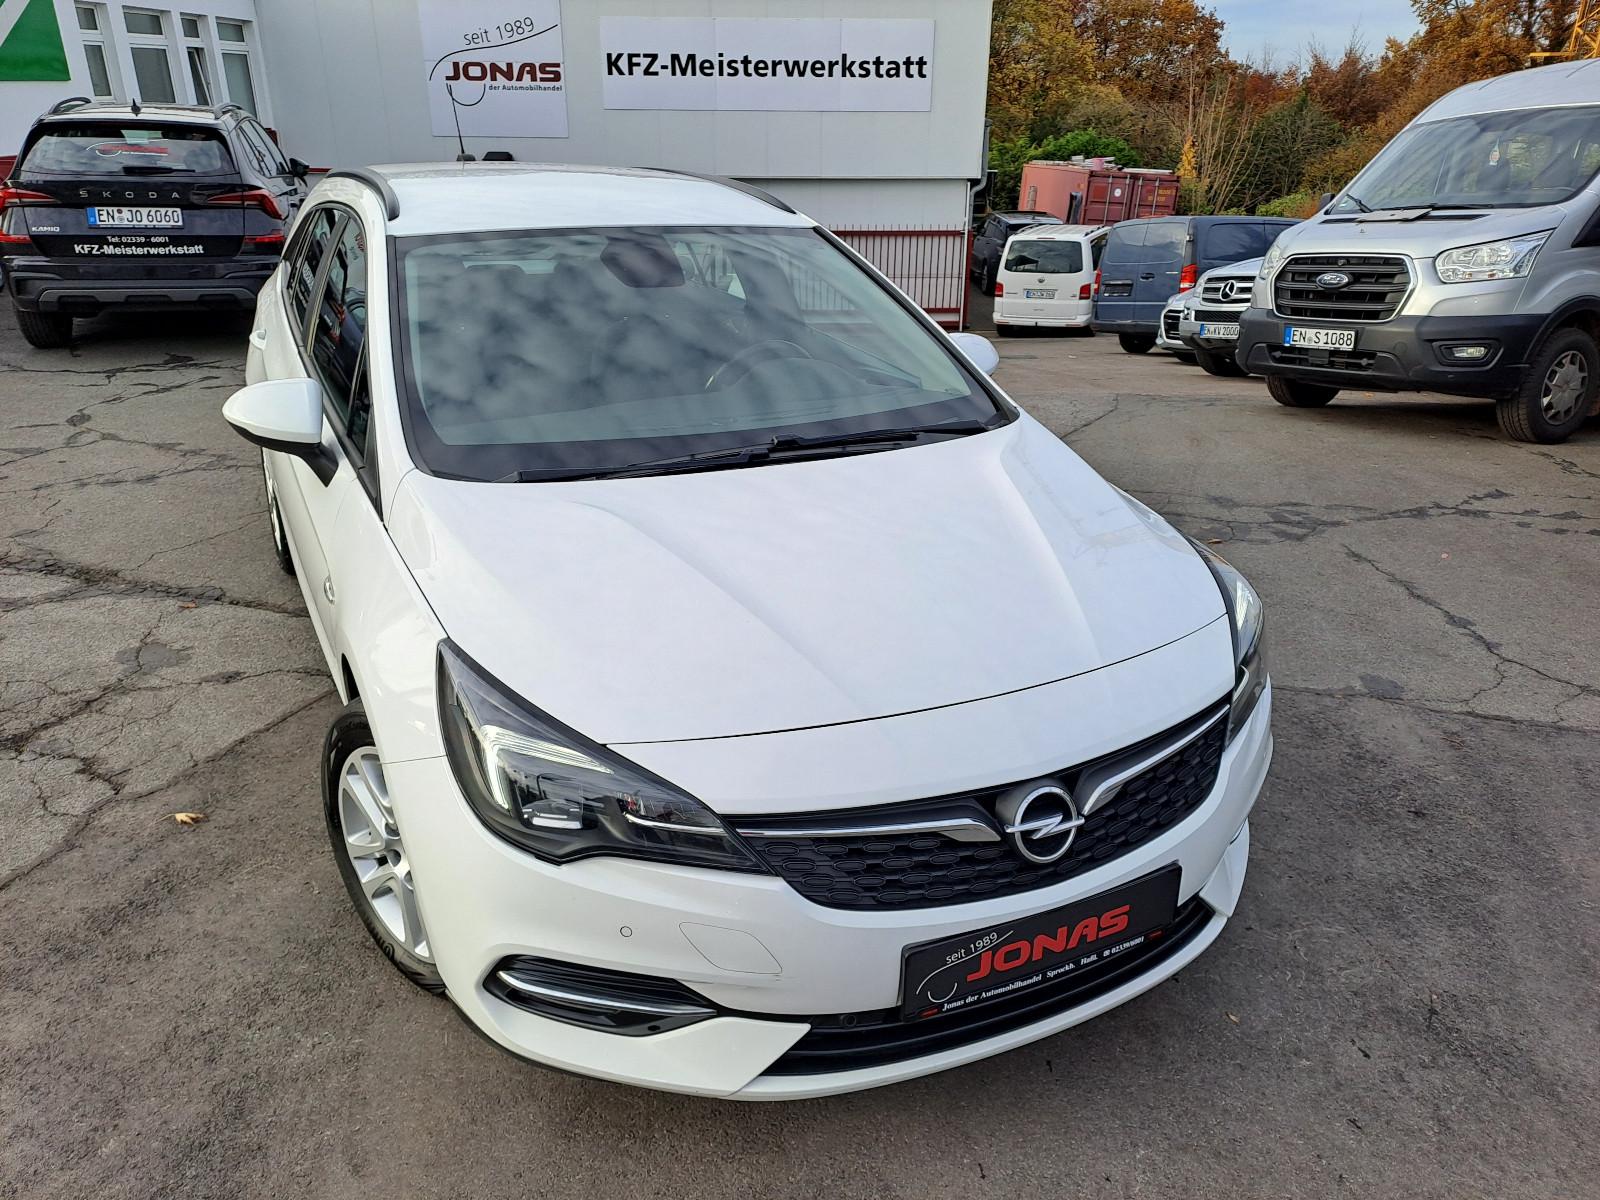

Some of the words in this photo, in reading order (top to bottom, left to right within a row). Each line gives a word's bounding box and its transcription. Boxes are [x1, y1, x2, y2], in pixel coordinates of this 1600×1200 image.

[463, 27, 491, 46] seit
[495, 16, 535, 40] 1989
[445, 61, 562, 83] JONAS
[606, 53, 928, 79] KFZ-Meisterwerkstatt
[502, 84, 563, 92] Automobilhandel
[98, 208, 116, 223] EN
[126, 209, 143, 223] JO
[147, 209, 181, 224] 6060
[74, 243, 204, 255] KFZ-Meisterwerkstatt
[1291, 329, 1308, 344] EN
[1313, 331, 1322, 345] S
[1323, 331, 1353, 347] 1088
[945, 948, 966, 965] seit
[969, 931, 998, 954] 1989
[966, 904, 1131, 982] JONAS
[942, 998, 965, 1012] Jonas
[965, 994, 979, 1004] der
[980, 973, 1043, 999] Automobilhandel
